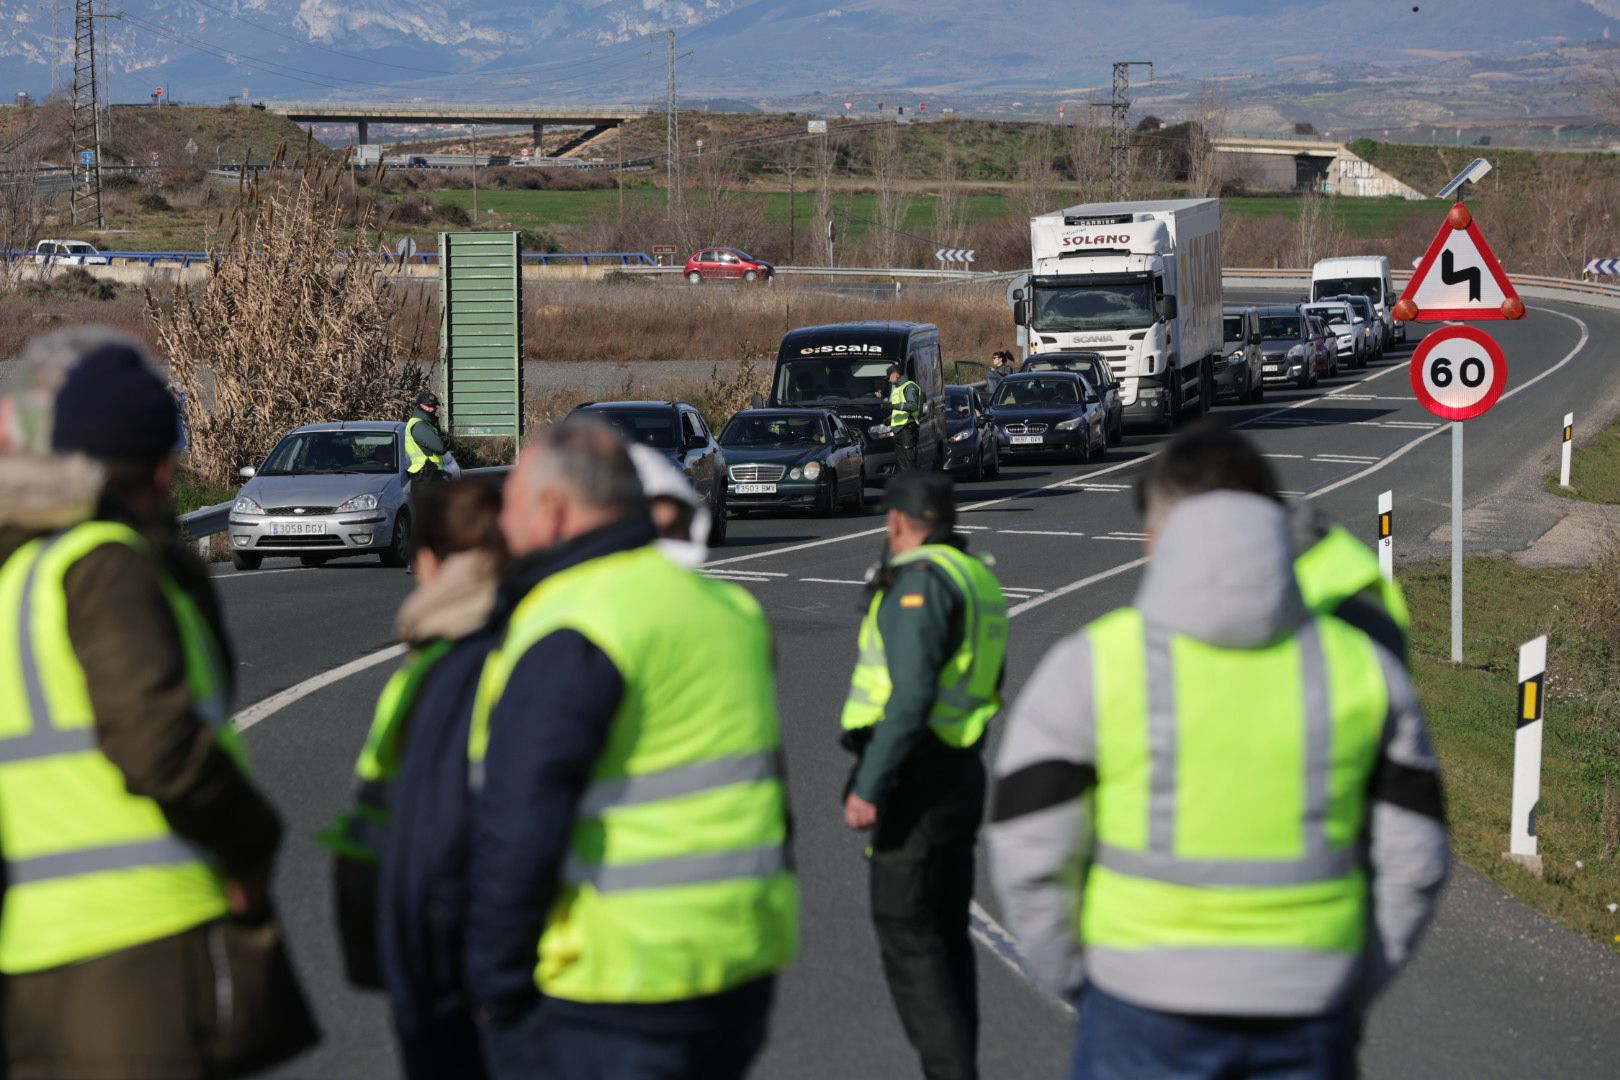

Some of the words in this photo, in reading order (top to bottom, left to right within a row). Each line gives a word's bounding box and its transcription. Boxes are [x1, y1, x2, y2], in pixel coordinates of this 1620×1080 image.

[1063, 234, 1131, 246] SOLANO
[1072, 335, 1113, 344] SCANIA
[1430, 357, 1486, 388] 60
[279, 524, 303, 534] 3058
[1384, 538, 1391, 547] 9
